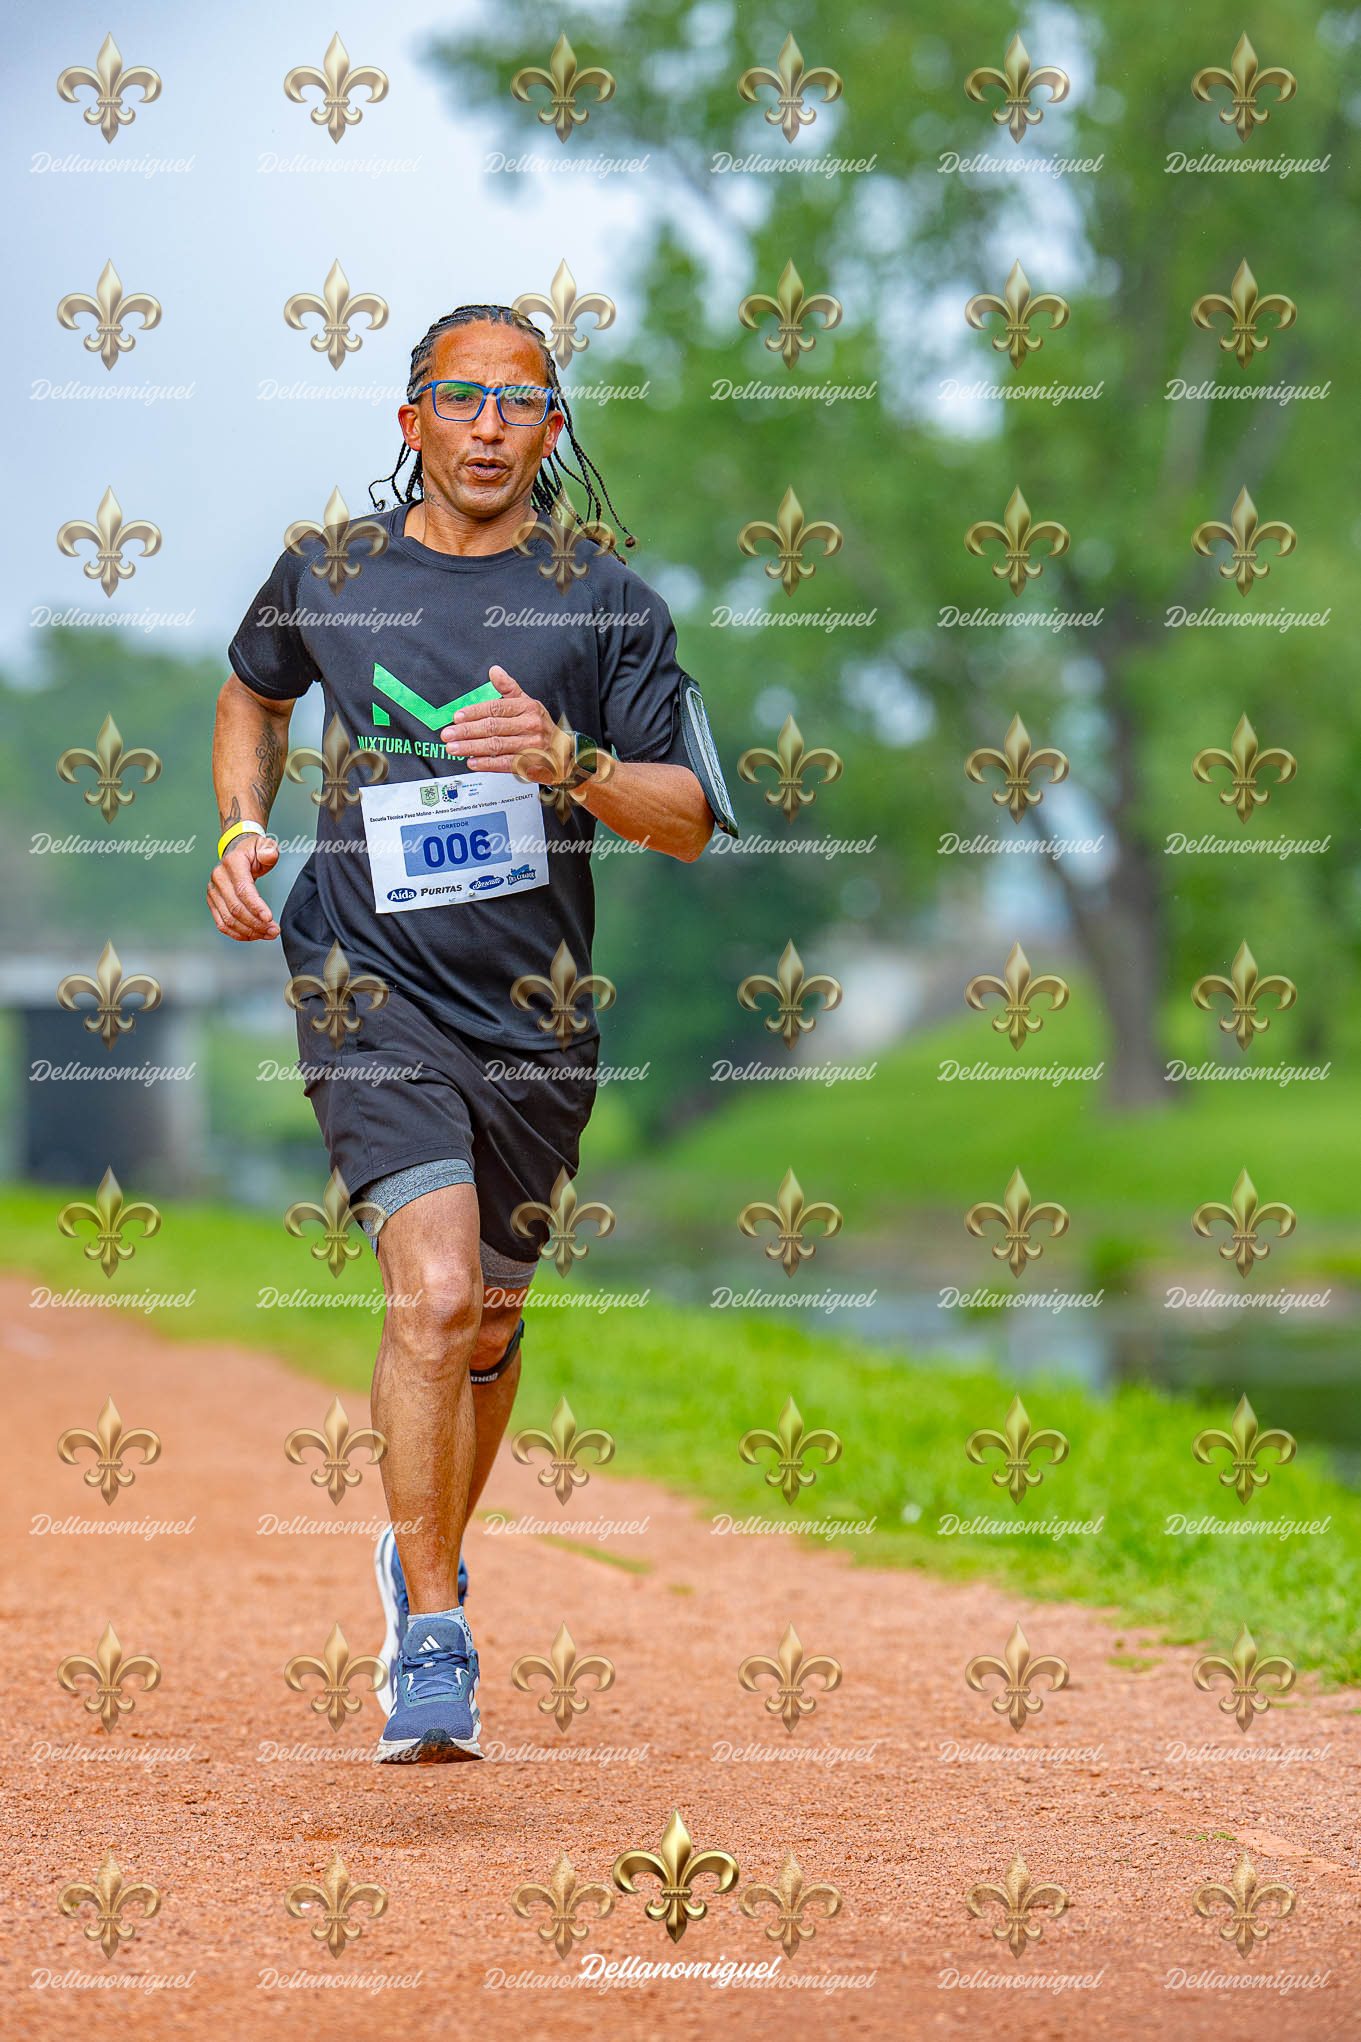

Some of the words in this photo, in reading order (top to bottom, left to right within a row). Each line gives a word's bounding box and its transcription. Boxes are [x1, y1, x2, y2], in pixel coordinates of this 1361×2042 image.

[438, 821, 469, 830] CORREDOR
[423, 829, 491, 868] 006
[390, 889, 415, 900] Aída
[420, 884, 462, 896] PURITAS
